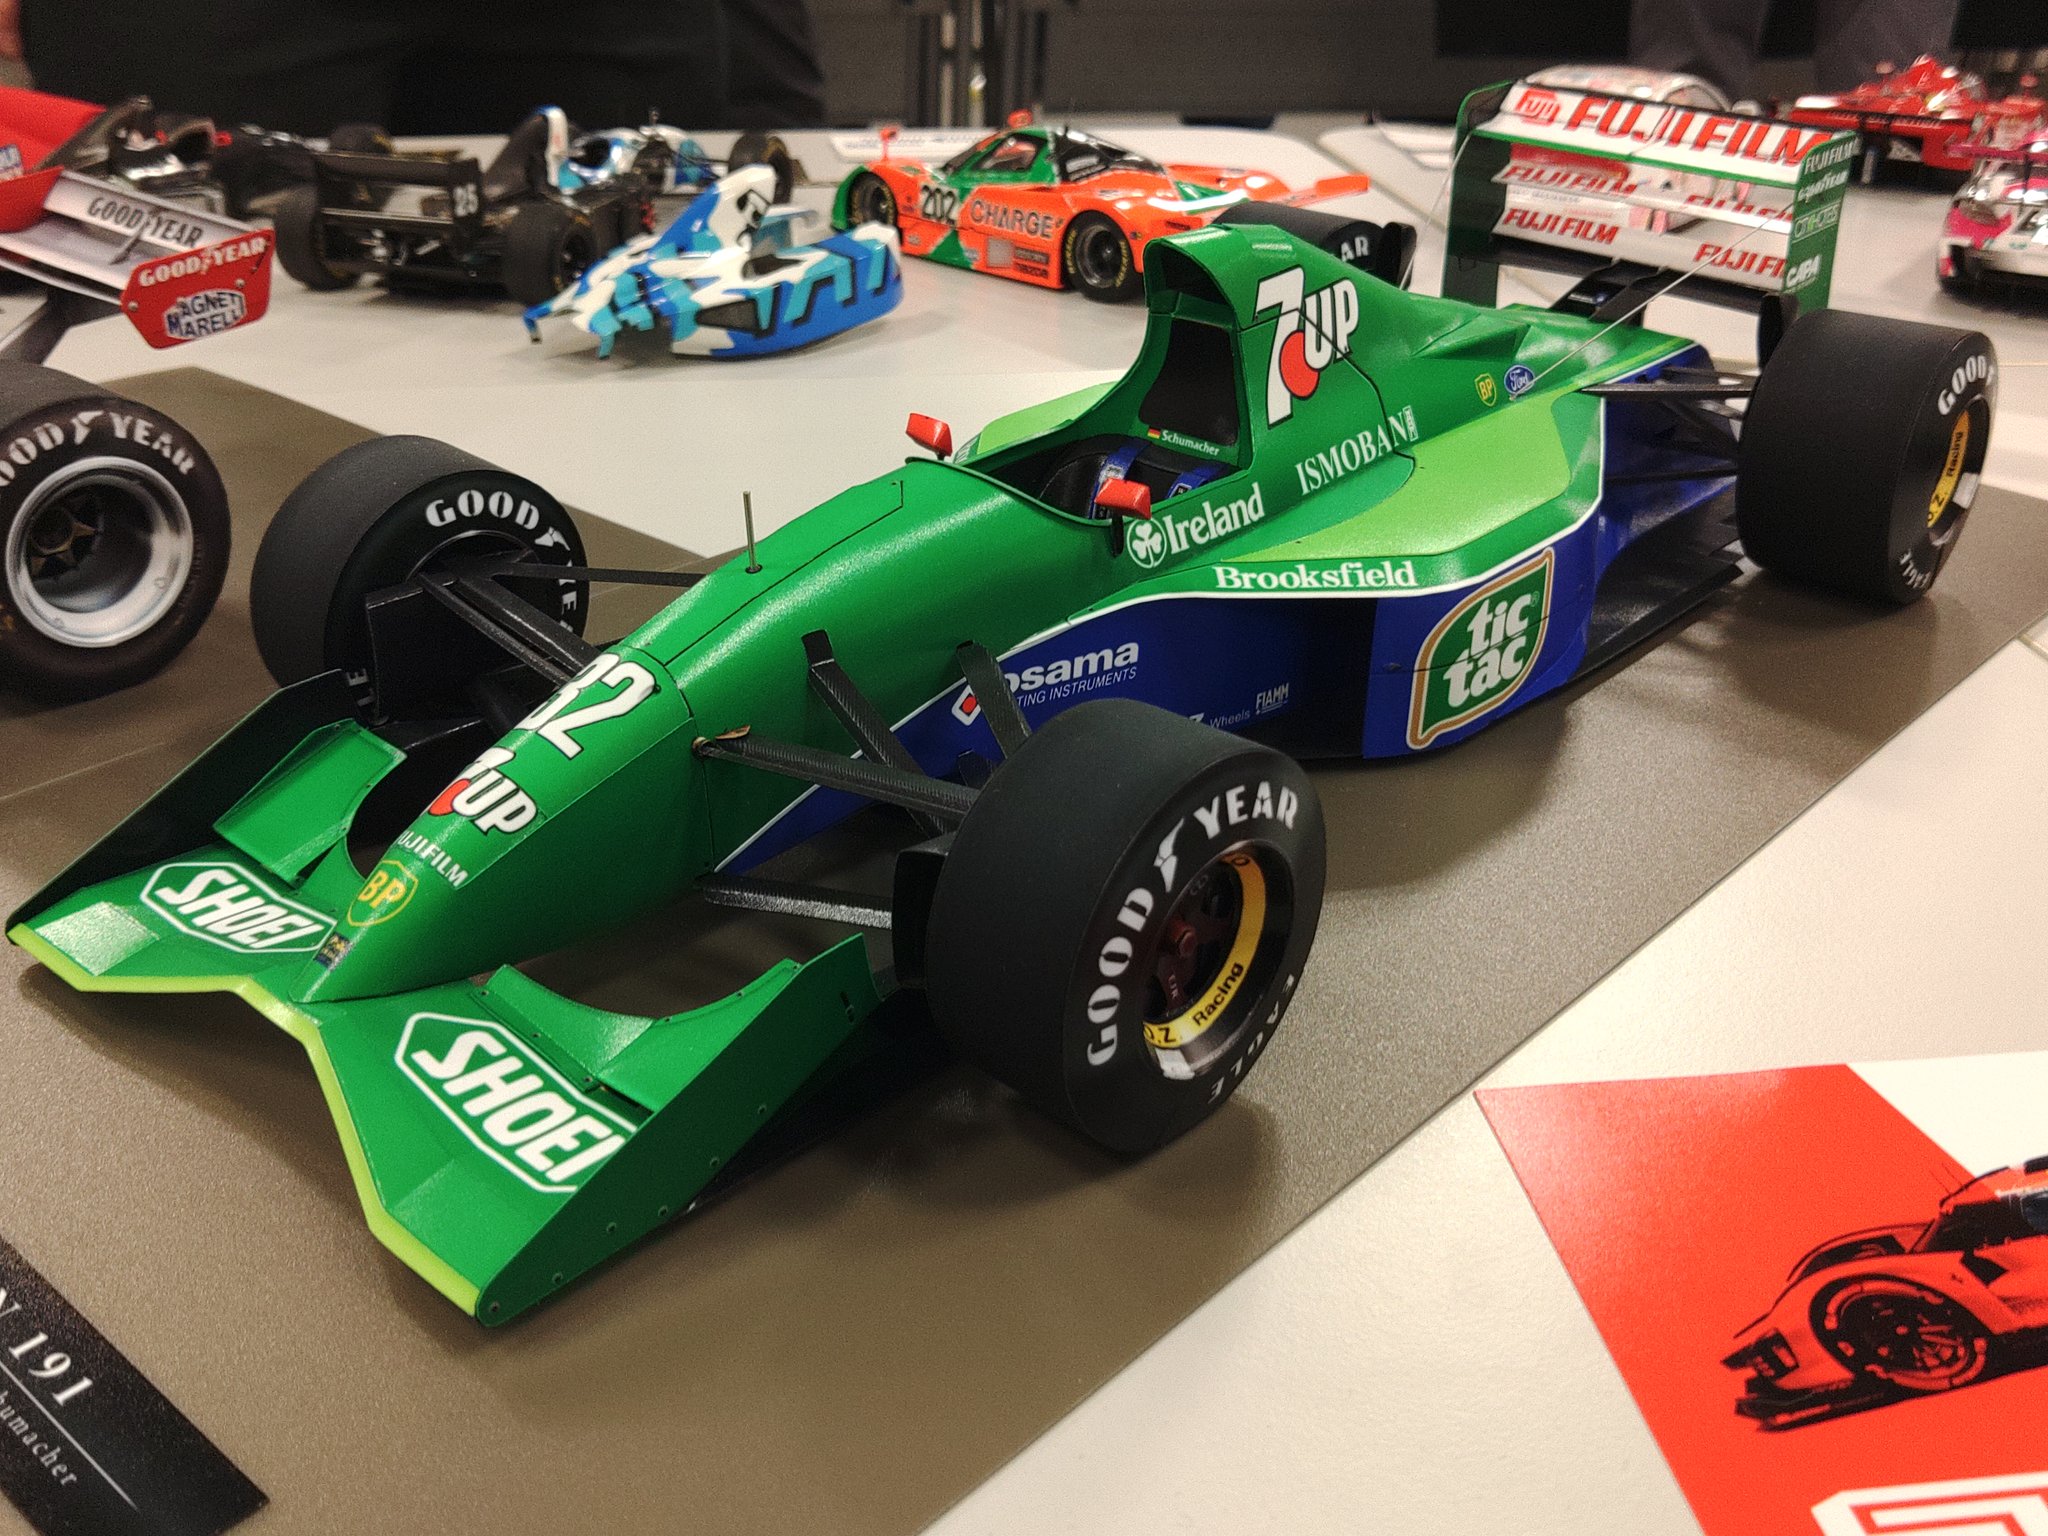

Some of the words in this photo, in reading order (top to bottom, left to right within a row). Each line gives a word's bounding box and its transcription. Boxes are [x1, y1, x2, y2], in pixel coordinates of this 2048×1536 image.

[1564, 96, 1833, 167] FUJIFILM
[921, 185, 957, 224] 202
[970, 200, 1053, 239] CHARGE
[1503, 208, 1619, 245] FUJIFILM
[1693, 243, 1787, 279] FUJIFI
[1255, 265, 1360, 429] 7UP
[1479, 378, 1493, 400] BP
[1161, 429, 1220, 456] Schumacher
[1295, 411, 1407, 495] ISMOBAN
[1163, 482, 1265, 555] Ireland
[1212, 561, 1419, 590] Brooksfield
[1467, 592, 1532, 658] tic
[1017, 690, 1046, 707] TING
[1049, 667, 1138, 701] INSTRUMENTS
[1256, 682, 1289, 709] FIAMM
[1442, 635, 1527, 708] tac
[1210, 710, 1251, 729] Wheels
[397, 831, 469, 887] UJIFILM
[154, 869, 325, 949] SHOEI
[358, 870, 406, 909] BP
[1193, 962, 1244, 1026] Racing
[411, 1030, 626, 1183] SHOEI
[8, 1331, 93, 1406] 191
